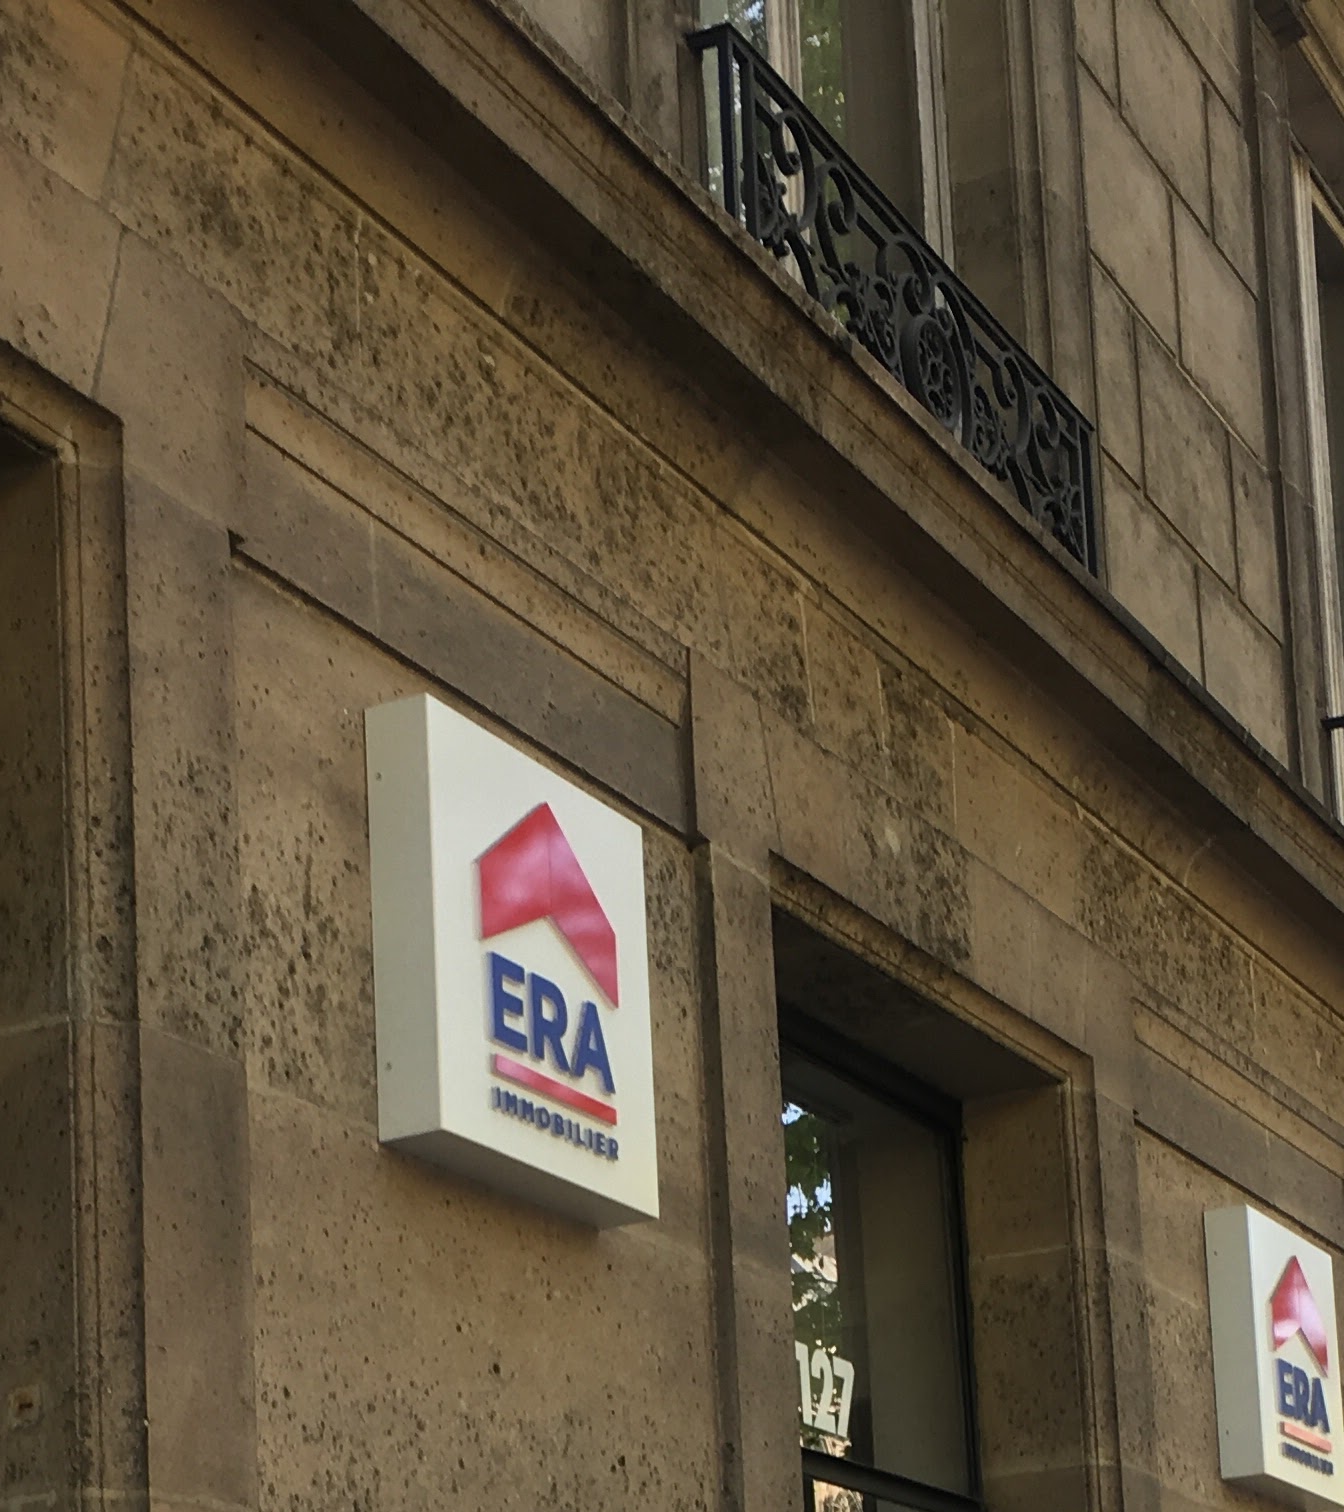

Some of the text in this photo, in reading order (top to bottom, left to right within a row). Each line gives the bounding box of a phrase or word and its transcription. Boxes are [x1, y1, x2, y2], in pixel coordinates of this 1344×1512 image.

[488, 951, 616, 1094] ERA
[491, 1086, 619, 1161] IMMOBILIER
[795, 1340, 855, 1438] 127
[1276, 1358, 1331, 1434] ERA
